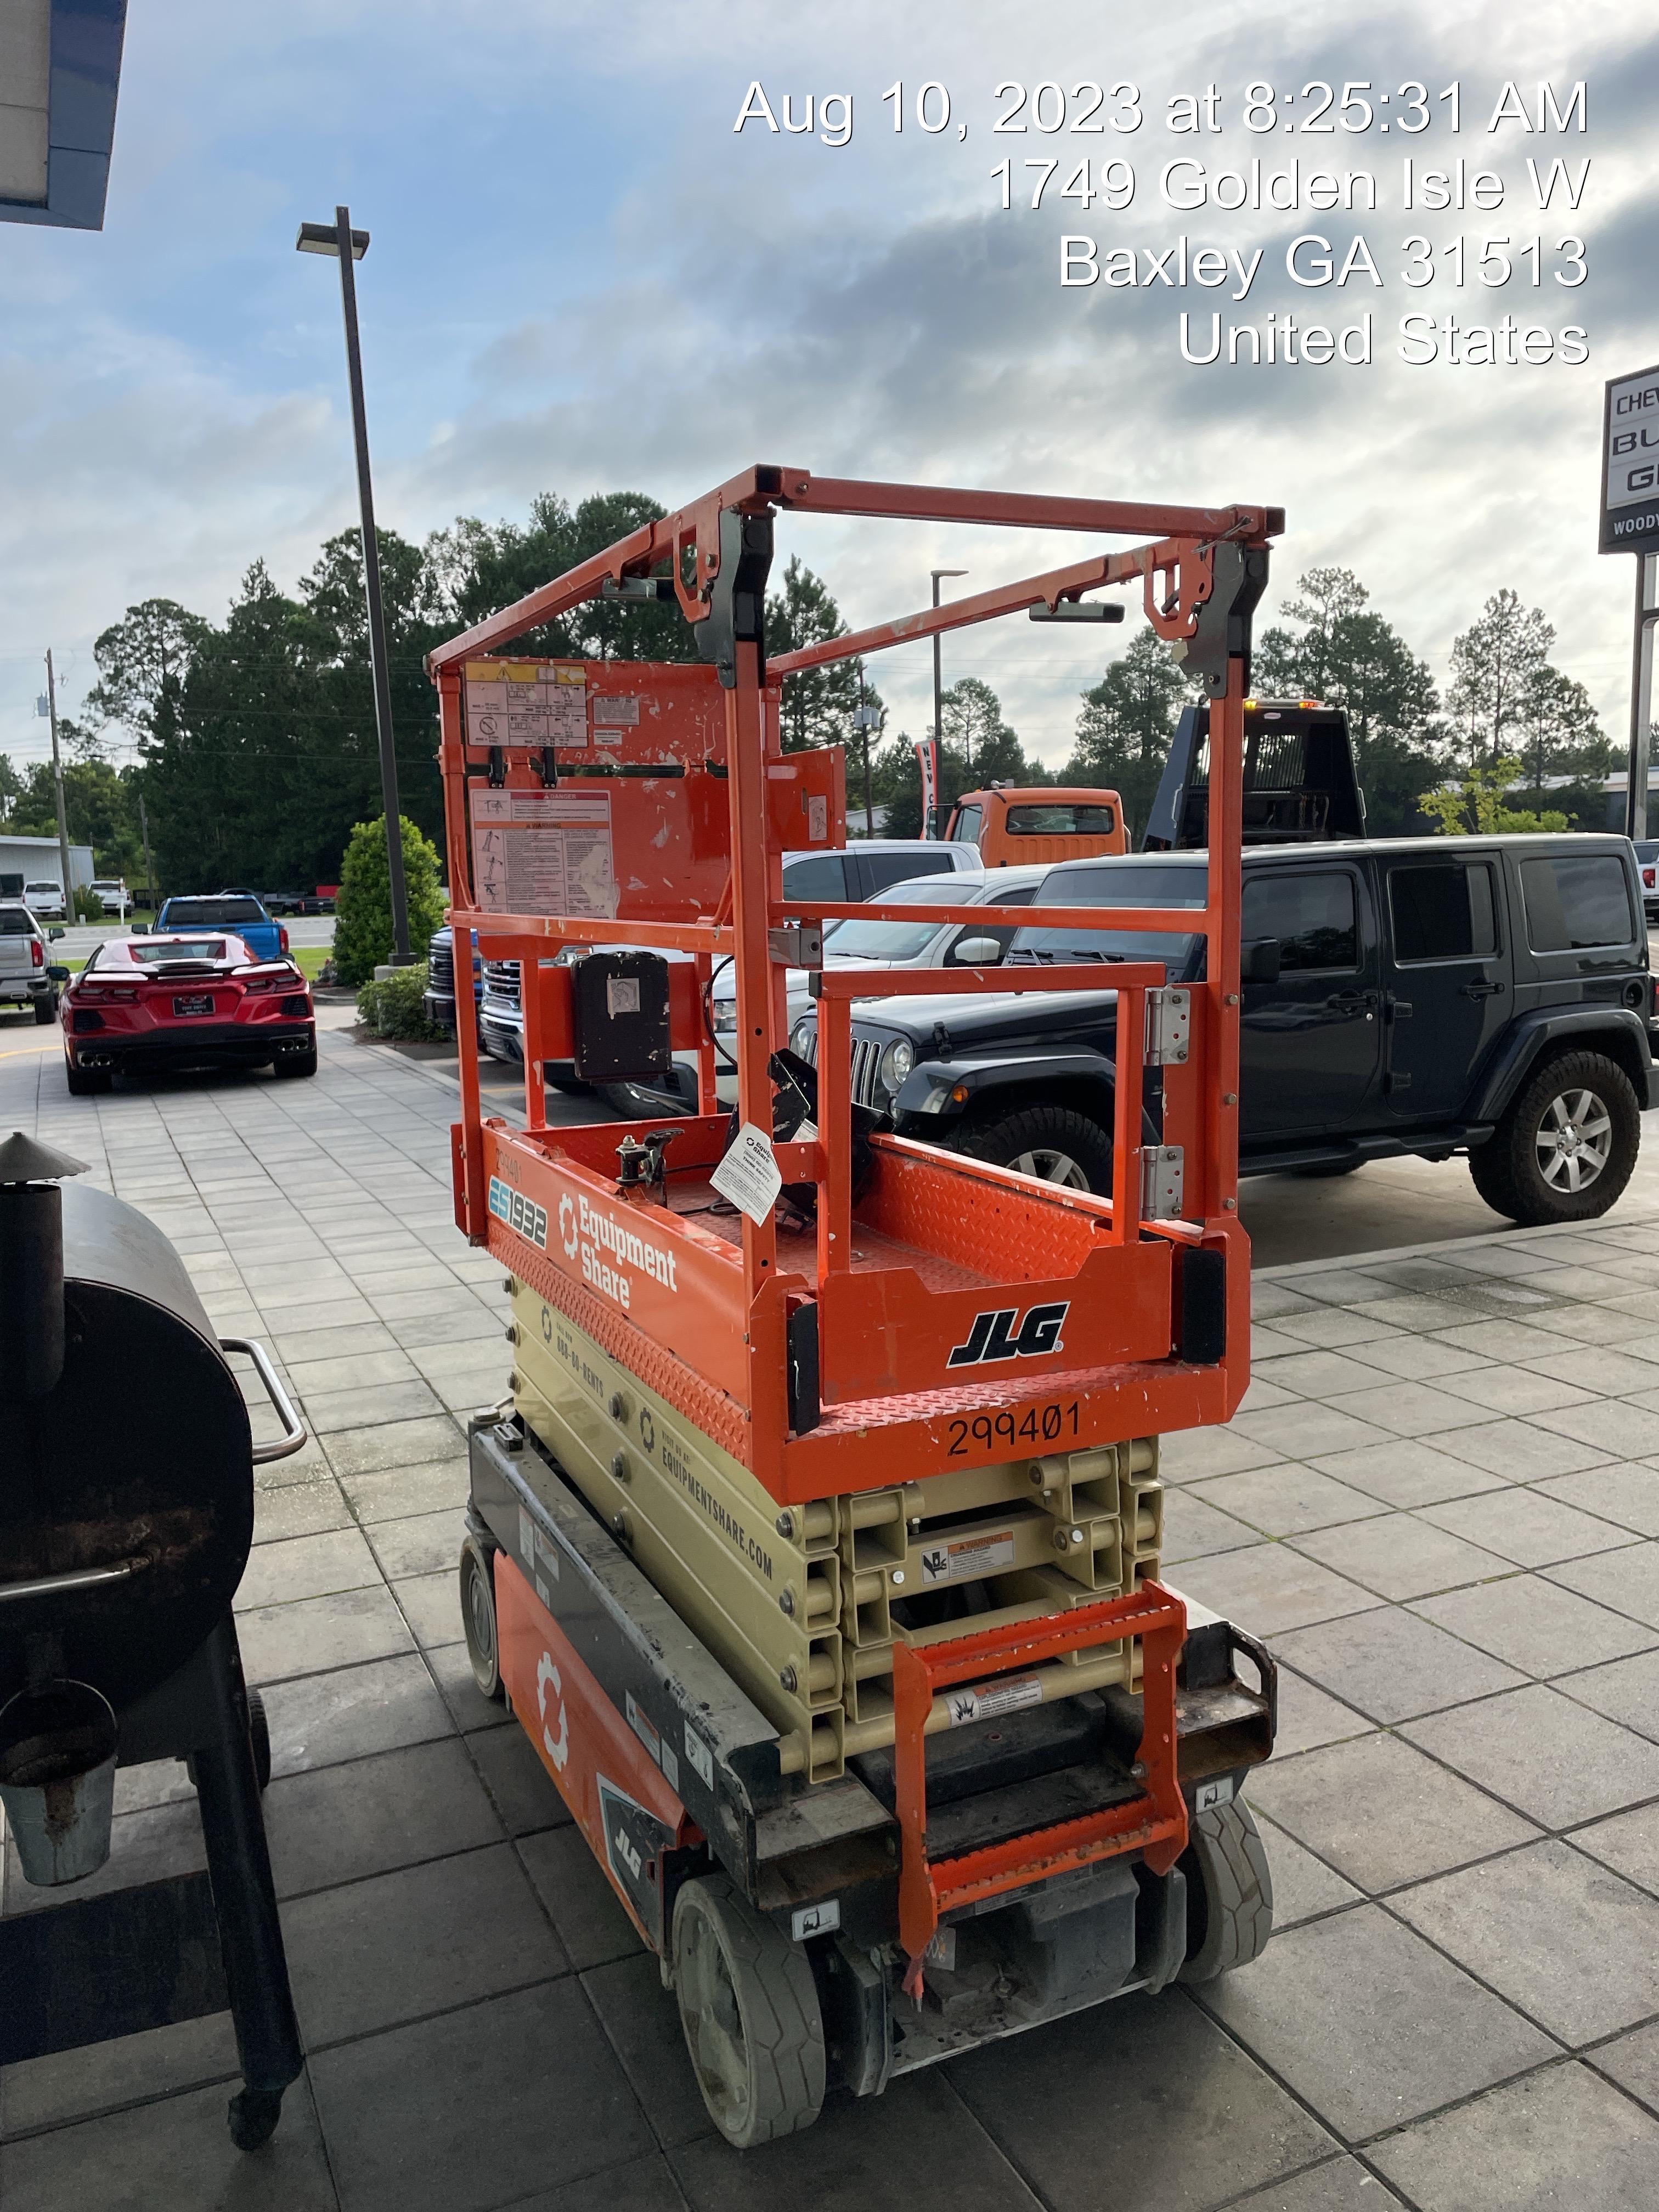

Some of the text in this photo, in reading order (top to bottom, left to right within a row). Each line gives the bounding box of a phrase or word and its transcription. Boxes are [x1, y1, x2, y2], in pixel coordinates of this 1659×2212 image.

[1627, 464, 1659, 492] G
[753, 1146, 770, 1164] Share
[756, 1167, 770, 1183] SAFETY
[489, 1177, 547, 1249] ES1932
[578, 1194, 677, 1293] Equipment
[580, 1241, 630, 1310] Share
[945, 1300, 1071, 1369] JLG
[947, 1401, 1079, 1457] 299401
[662, 1445, 773, 1581] EQUIPMENTSHARE.COM
[966, 1536, 1003, 1549] WARNING
[615, 1827, 641, 1881] JLG
